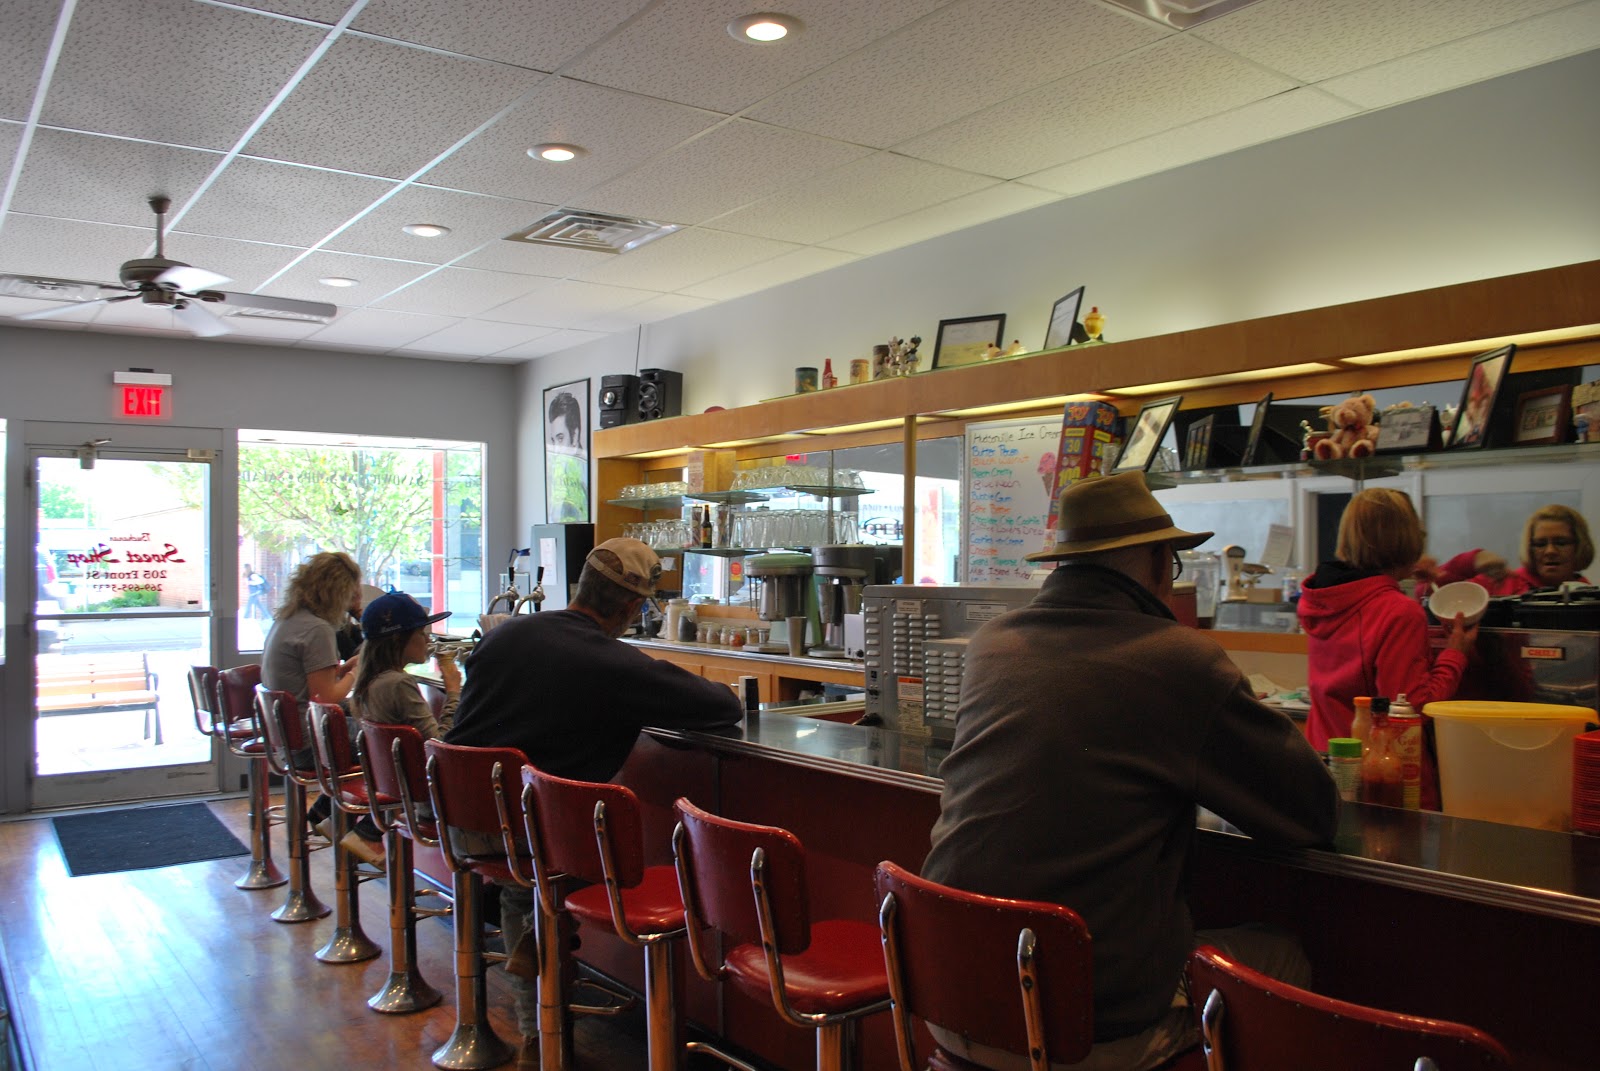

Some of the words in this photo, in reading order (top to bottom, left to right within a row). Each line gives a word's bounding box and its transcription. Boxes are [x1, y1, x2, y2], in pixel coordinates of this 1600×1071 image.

[124, 387, 162, 416] EXIT
[1018, 427, 1035, 441] Ice
[1022, 526, 1045, 536] Drea
